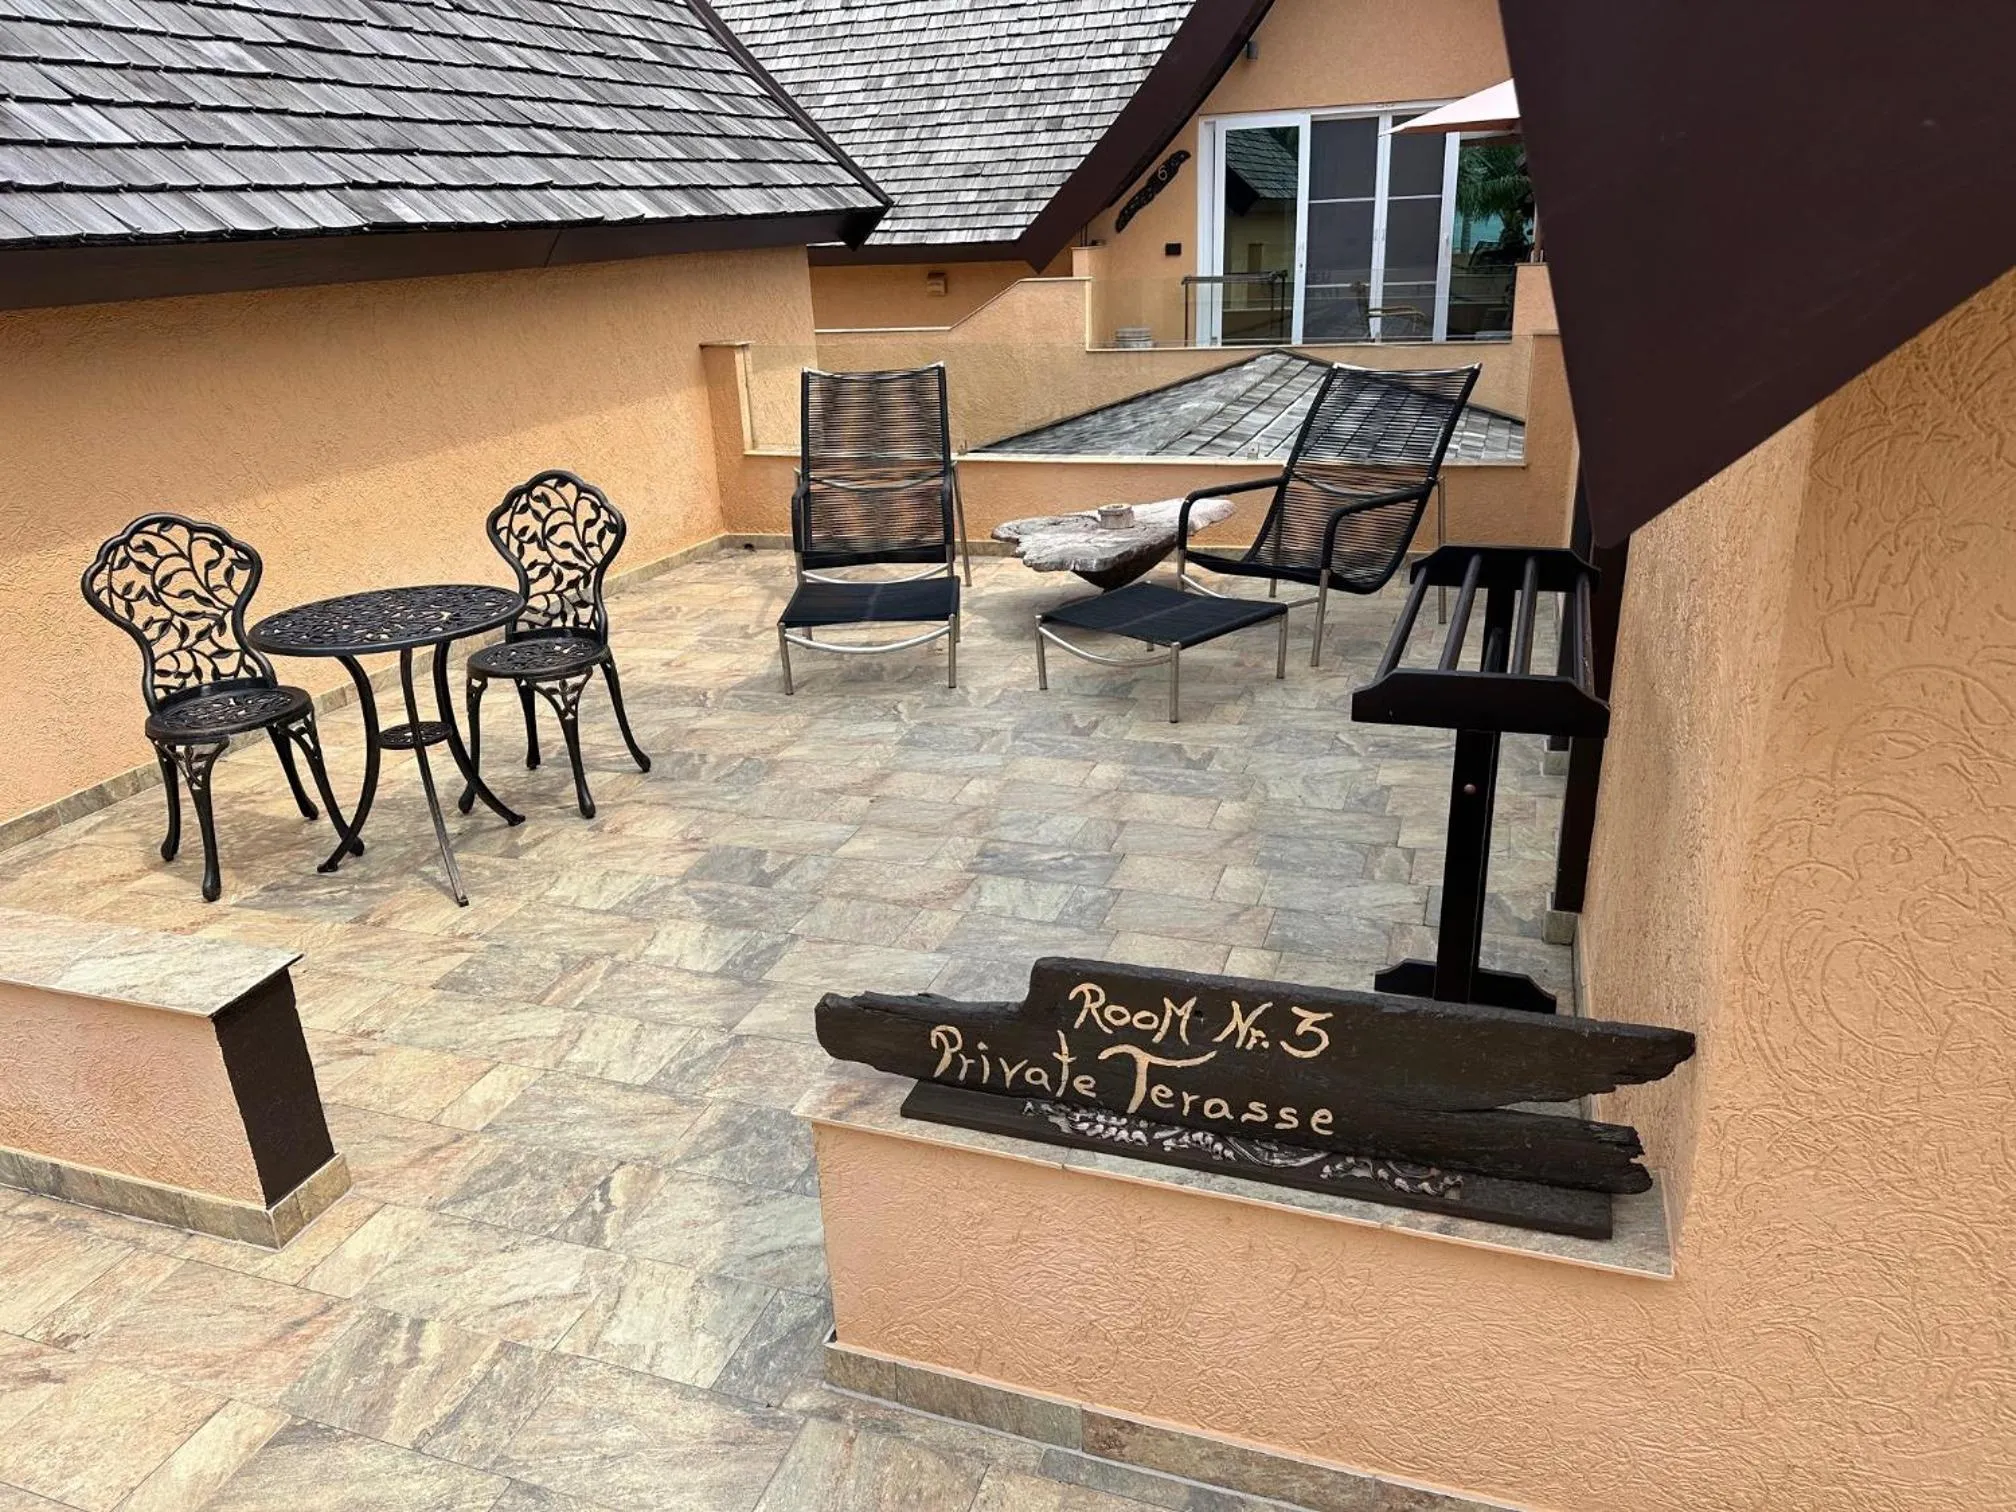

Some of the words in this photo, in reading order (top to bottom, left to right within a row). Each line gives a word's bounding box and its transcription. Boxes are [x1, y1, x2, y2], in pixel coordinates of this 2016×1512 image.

[1158, 166, 1168, 180] 6
[1212, 1000, 1274, 1051] Nr.
[930, 1024, 1097, 1098] Private
[1098, 1043, 1334, 1136] Terasse
